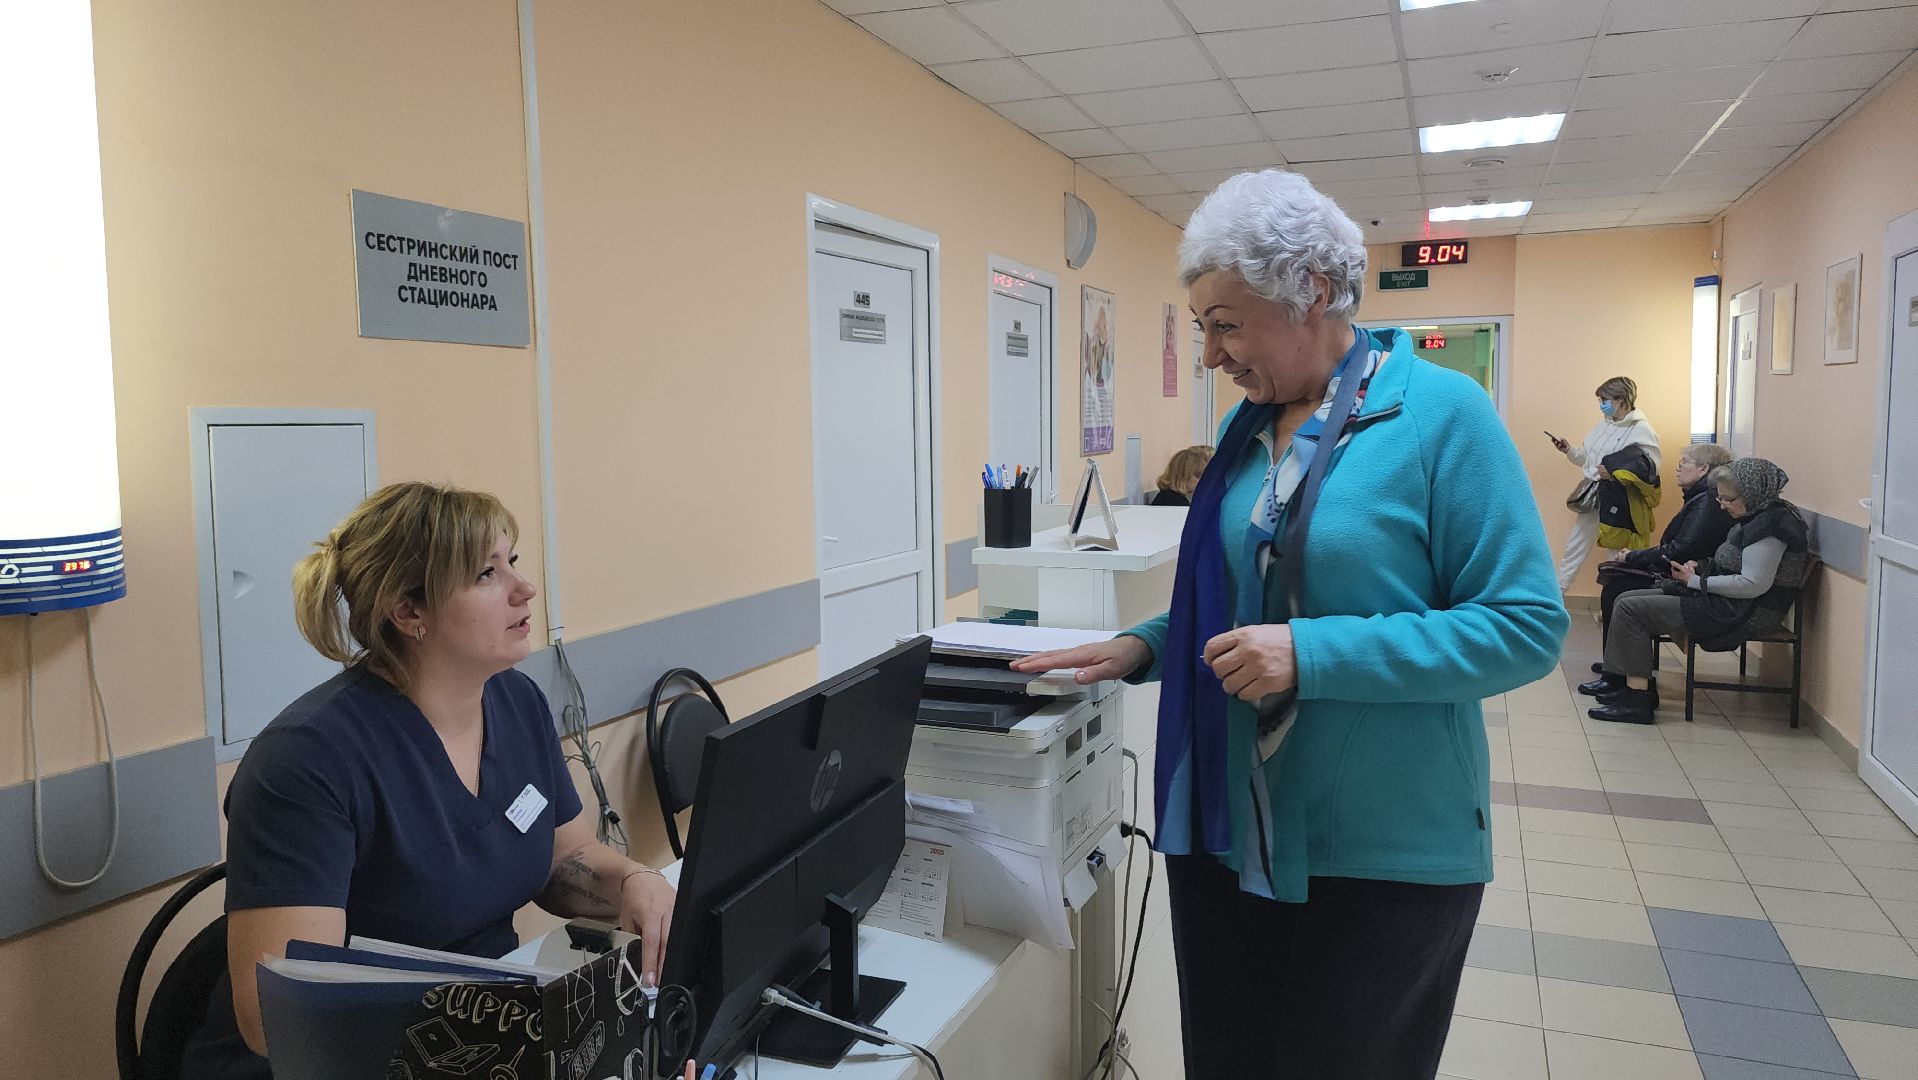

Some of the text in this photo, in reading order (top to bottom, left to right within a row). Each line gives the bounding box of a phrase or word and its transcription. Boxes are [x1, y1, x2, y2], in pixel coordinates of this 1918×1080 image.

[365, 231, 519, 271] СЕСТРИНСКИЙ ПОСТ
[1417, 245, 1465, 263] 9.04
[407, 262, 488, 288] ДНЕВНОГО
[1391, 272, 1416, 282] ВЫХОД
[397, 284, 498, 311] СТАЦИОНАРА
[855, 293, 870, 306] 445
